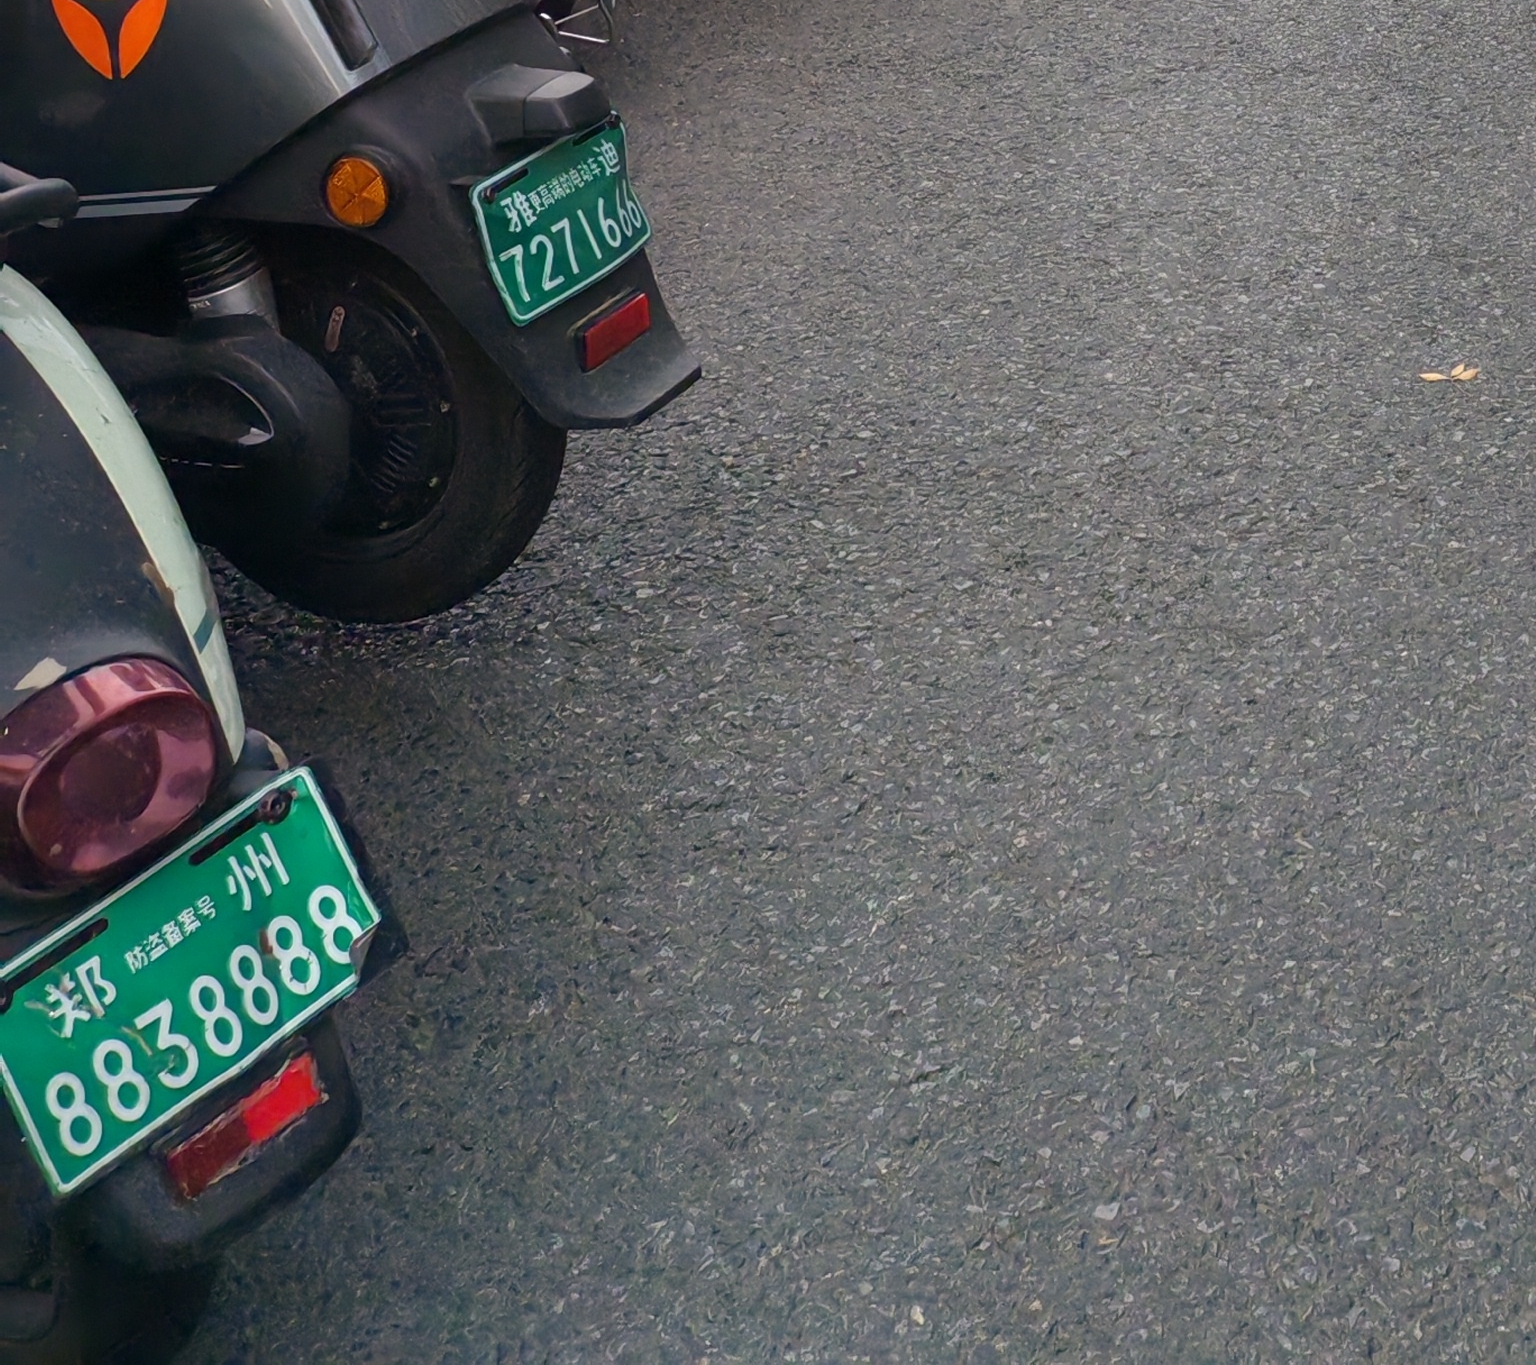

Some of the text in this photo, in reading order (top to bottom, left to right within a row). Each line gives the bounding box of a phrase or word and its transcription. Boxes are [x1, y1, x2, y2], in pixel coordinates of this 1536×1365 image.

[499, 179, 642, 303] 7271666
[500, 190, 537, 232] 雅
[594, 139, 620, 177] 迪
[46, 833, 291, 1038] 郑 防盗备案号 州
[46, 885, 364, 1158] 8838888
